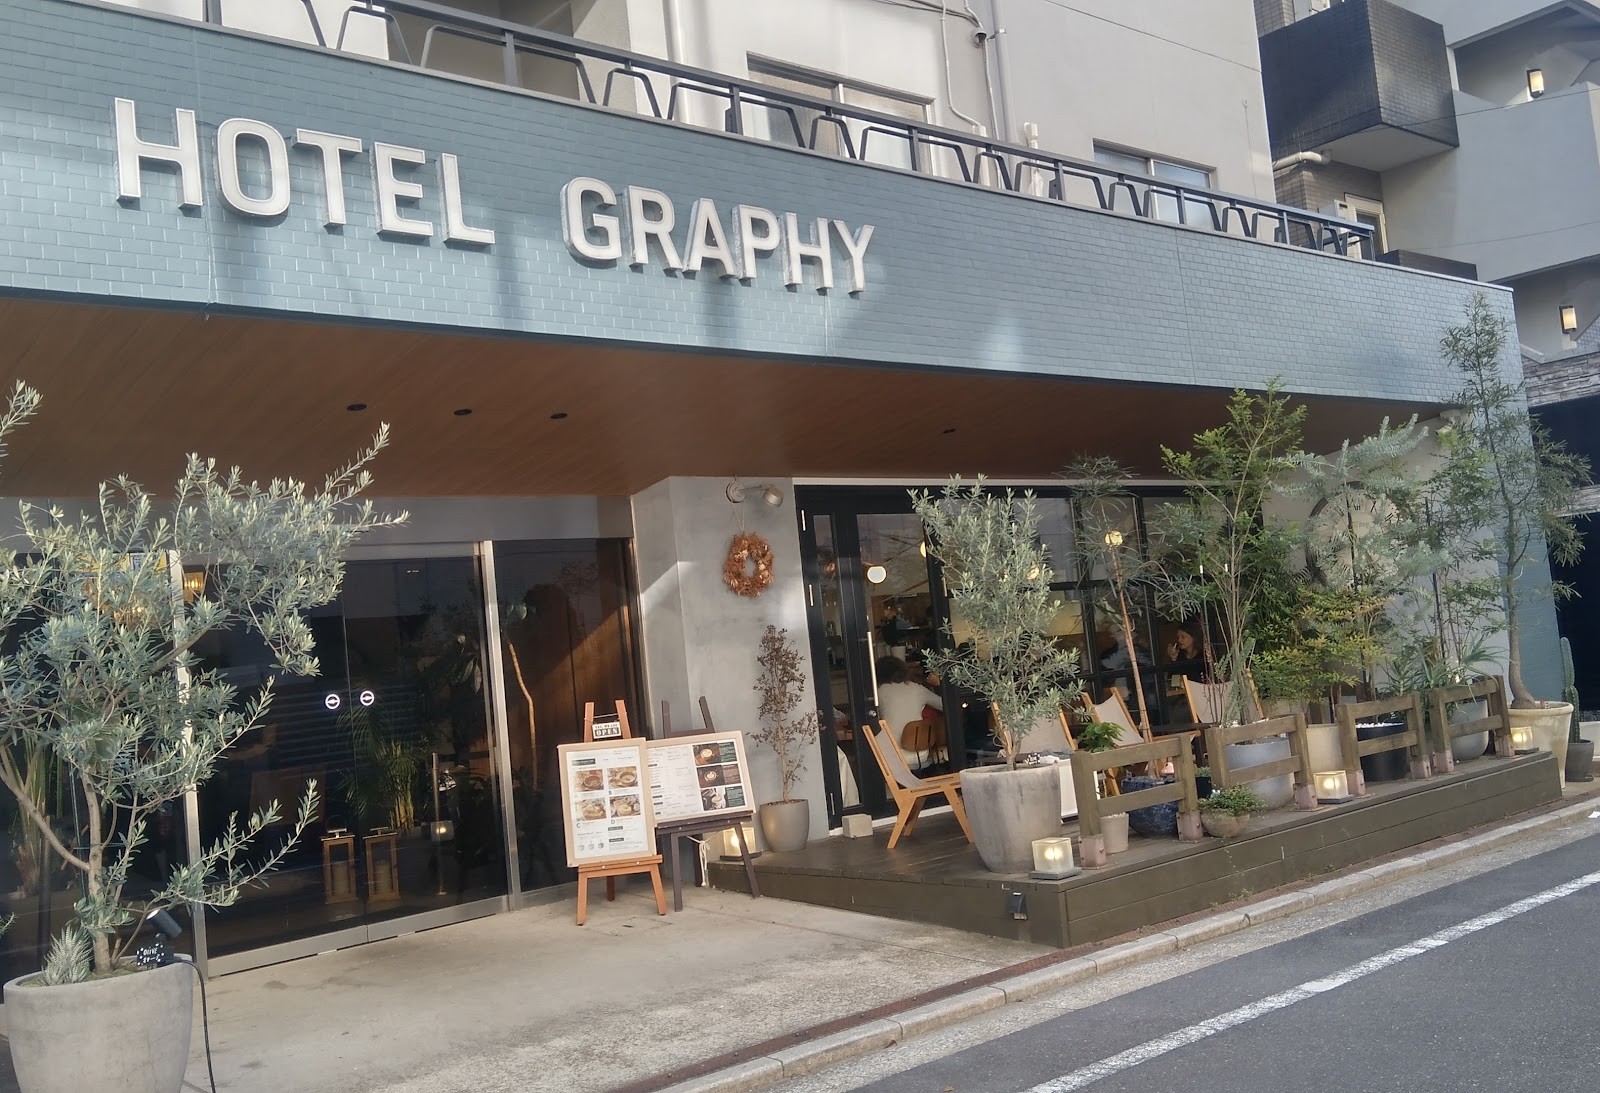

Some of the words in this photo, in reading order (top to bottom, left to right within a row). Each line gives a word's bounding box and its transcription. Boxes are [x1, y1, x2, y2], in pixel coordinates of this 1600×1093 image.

[114, 97, 496, 245] HOTEL
[560, 177, 875, 295] GRAPHY
[595, 728, 619, 736] OPEN
